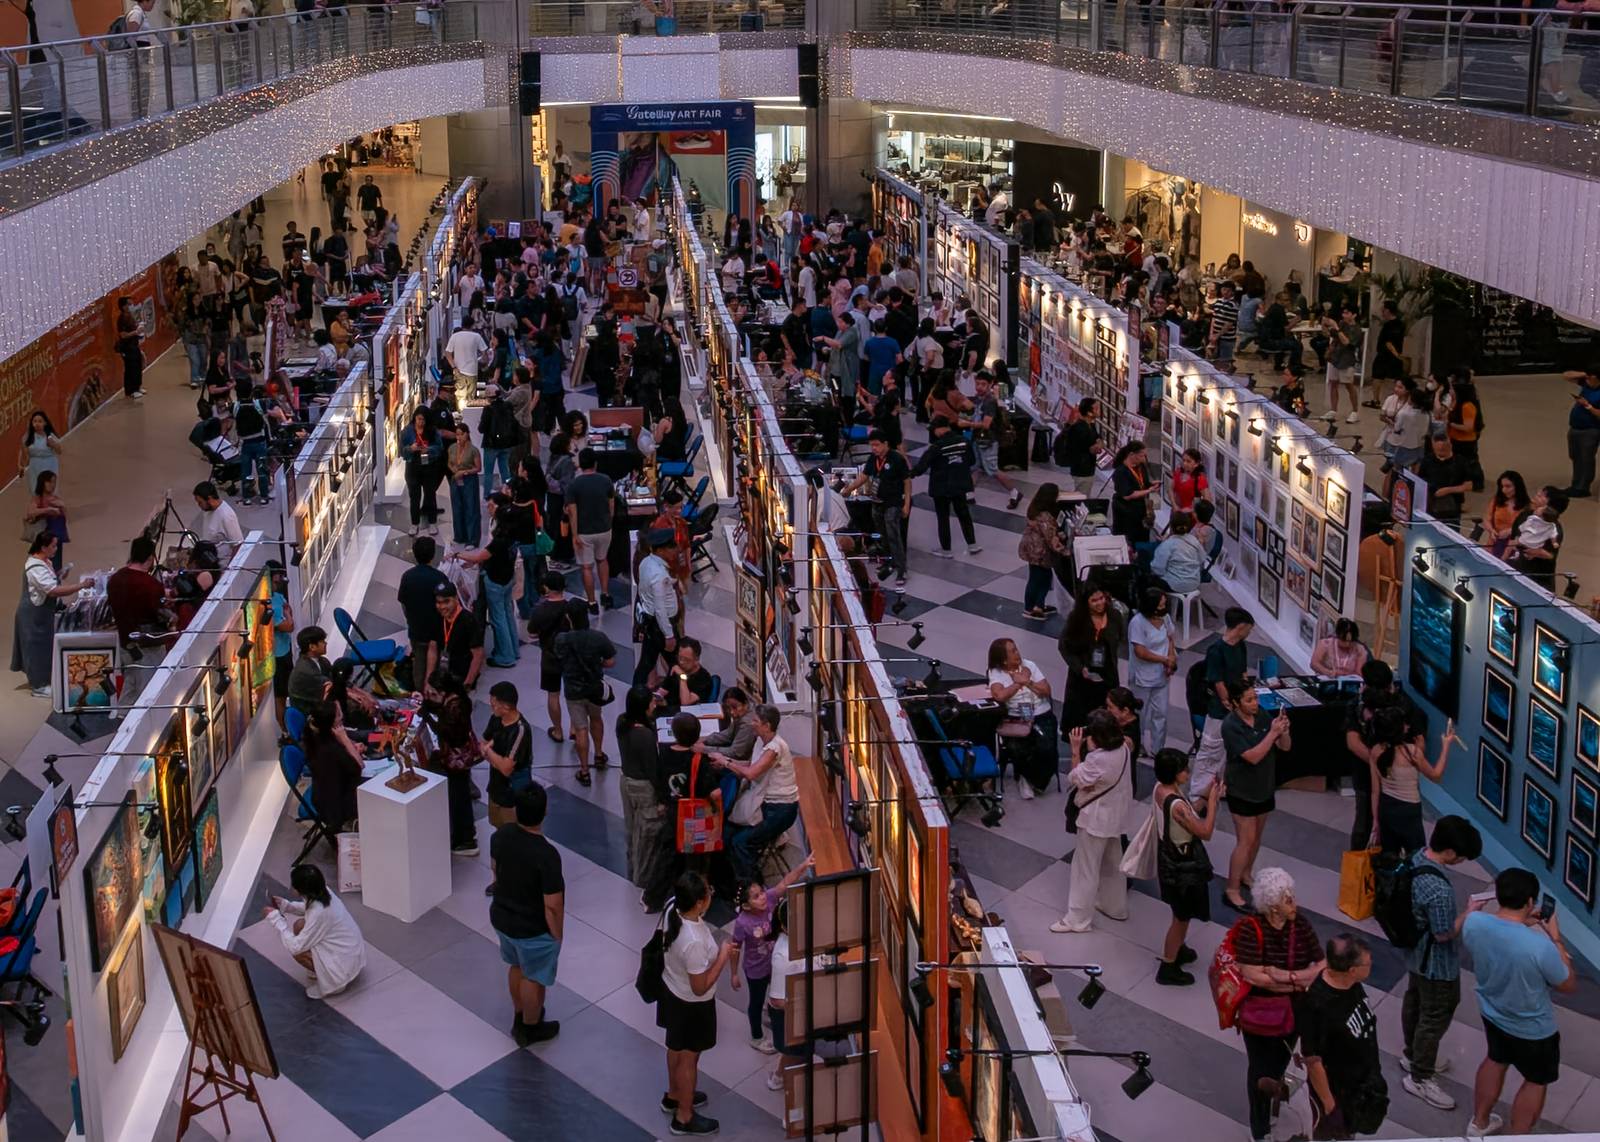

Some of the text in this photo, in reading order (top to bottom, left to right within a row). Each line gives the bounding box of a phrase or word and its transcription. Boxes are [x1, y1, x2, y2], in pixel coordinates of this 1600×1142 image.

[677, 110, 697, 119] ART
[699, 109, 721, 118] FAIR
[0, 346, 53, 401] OMETHING
